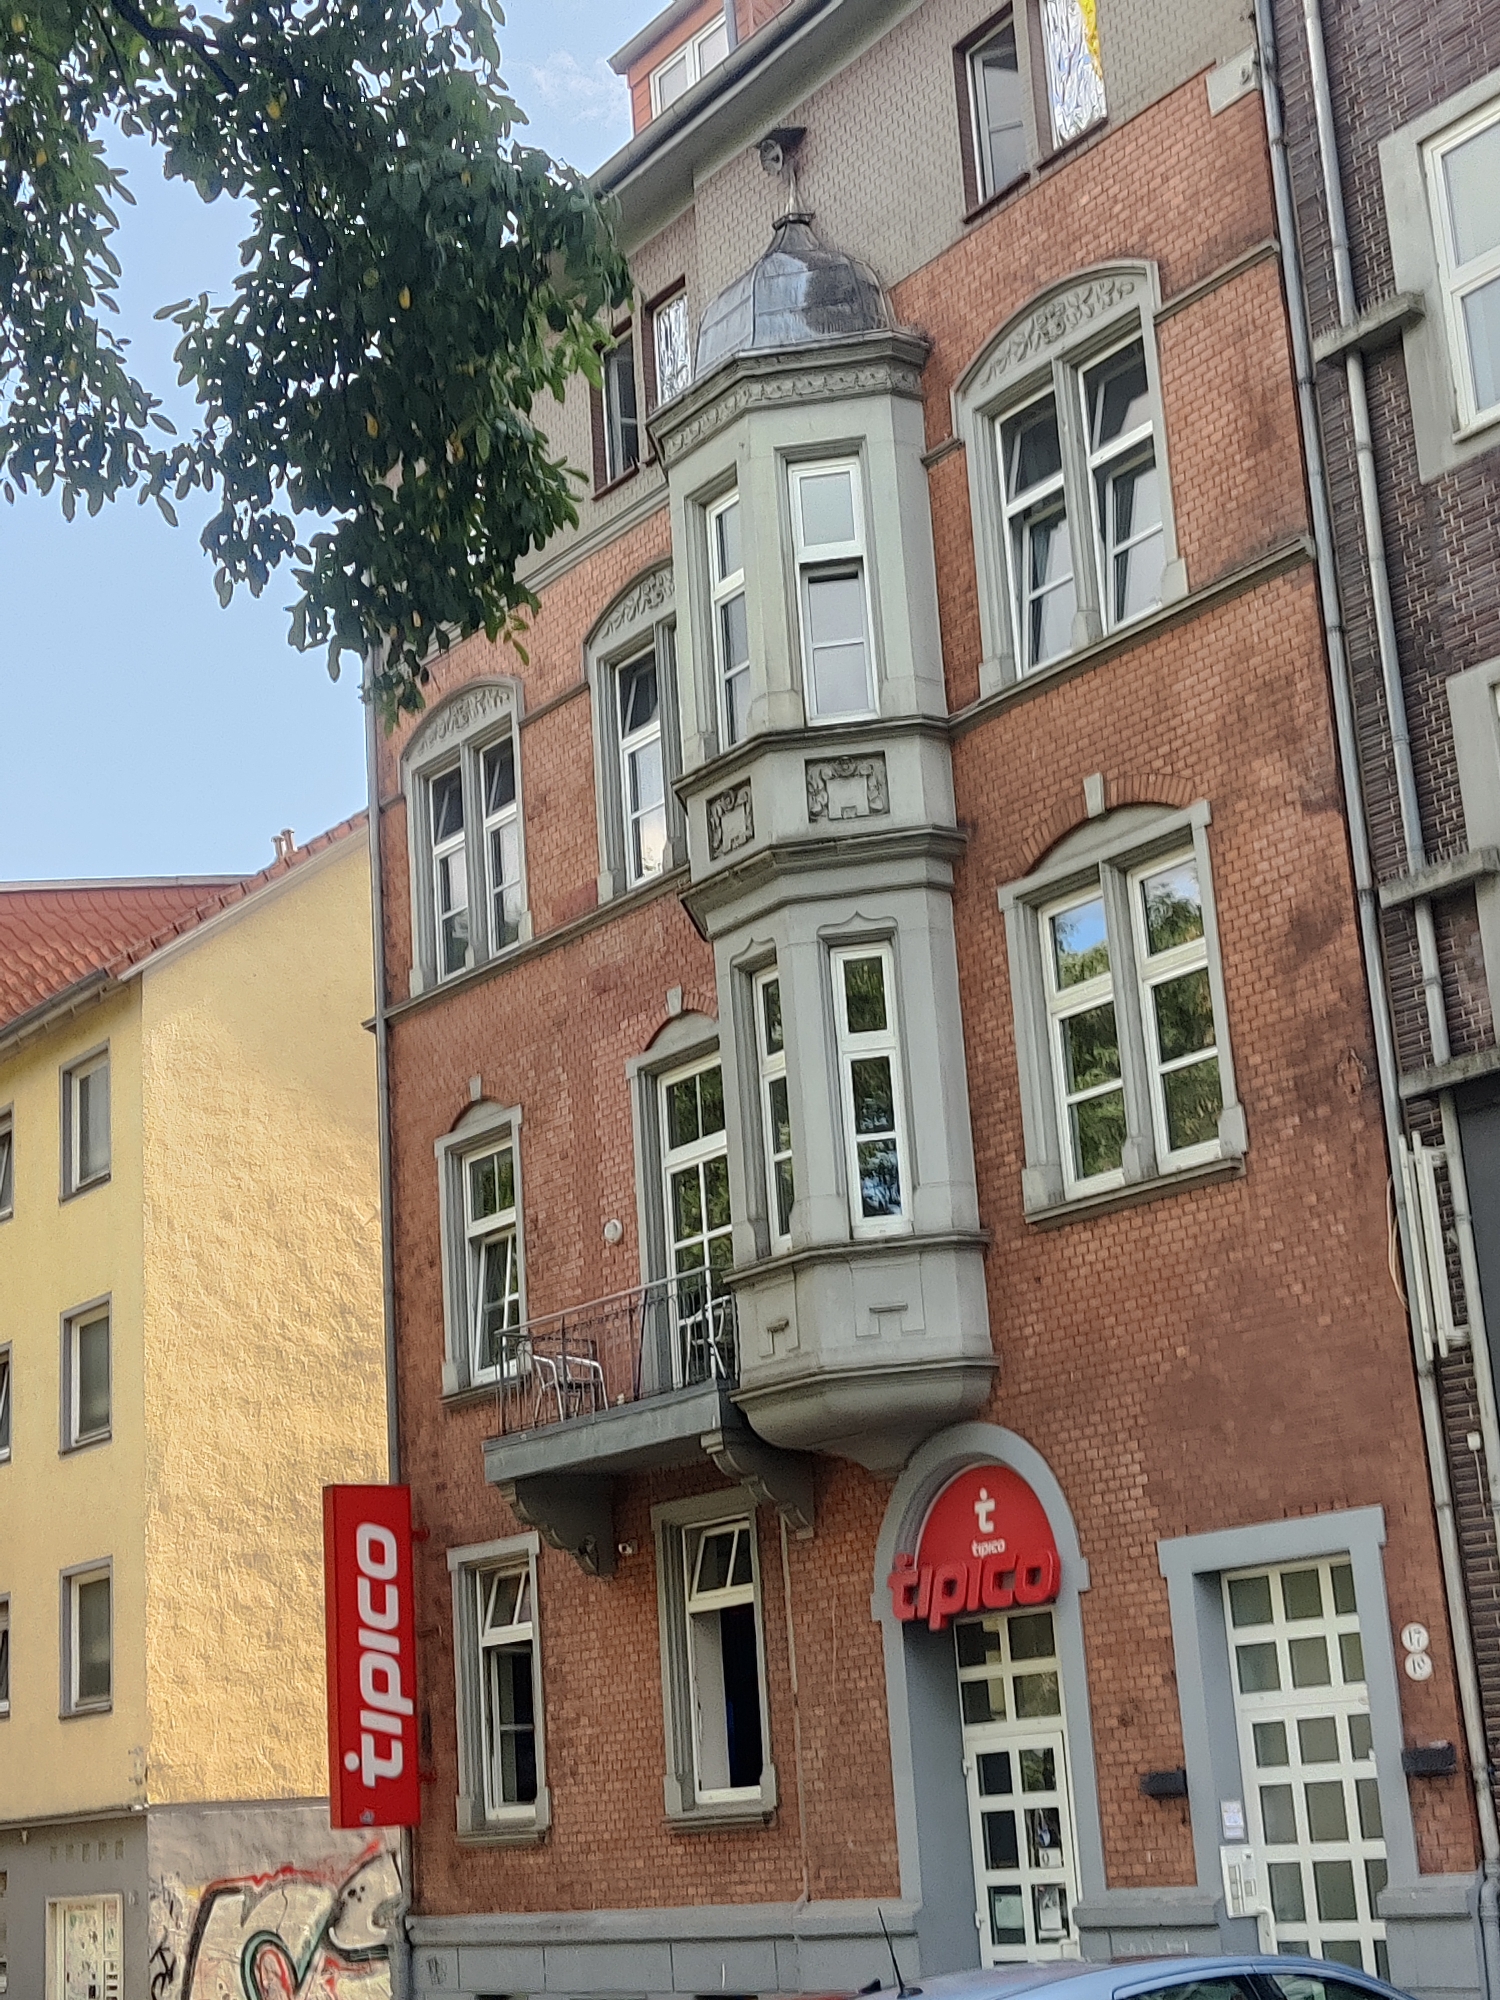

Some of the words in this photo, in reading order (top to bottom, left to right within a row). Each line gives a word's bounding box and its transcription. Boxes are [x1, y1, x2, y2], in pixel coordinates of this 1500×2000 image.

[971, 1538, 1006, 1558] tipico
[887, 1552, 1062, 1631] tipico
[344, 1522, 414, 1788] tipico
